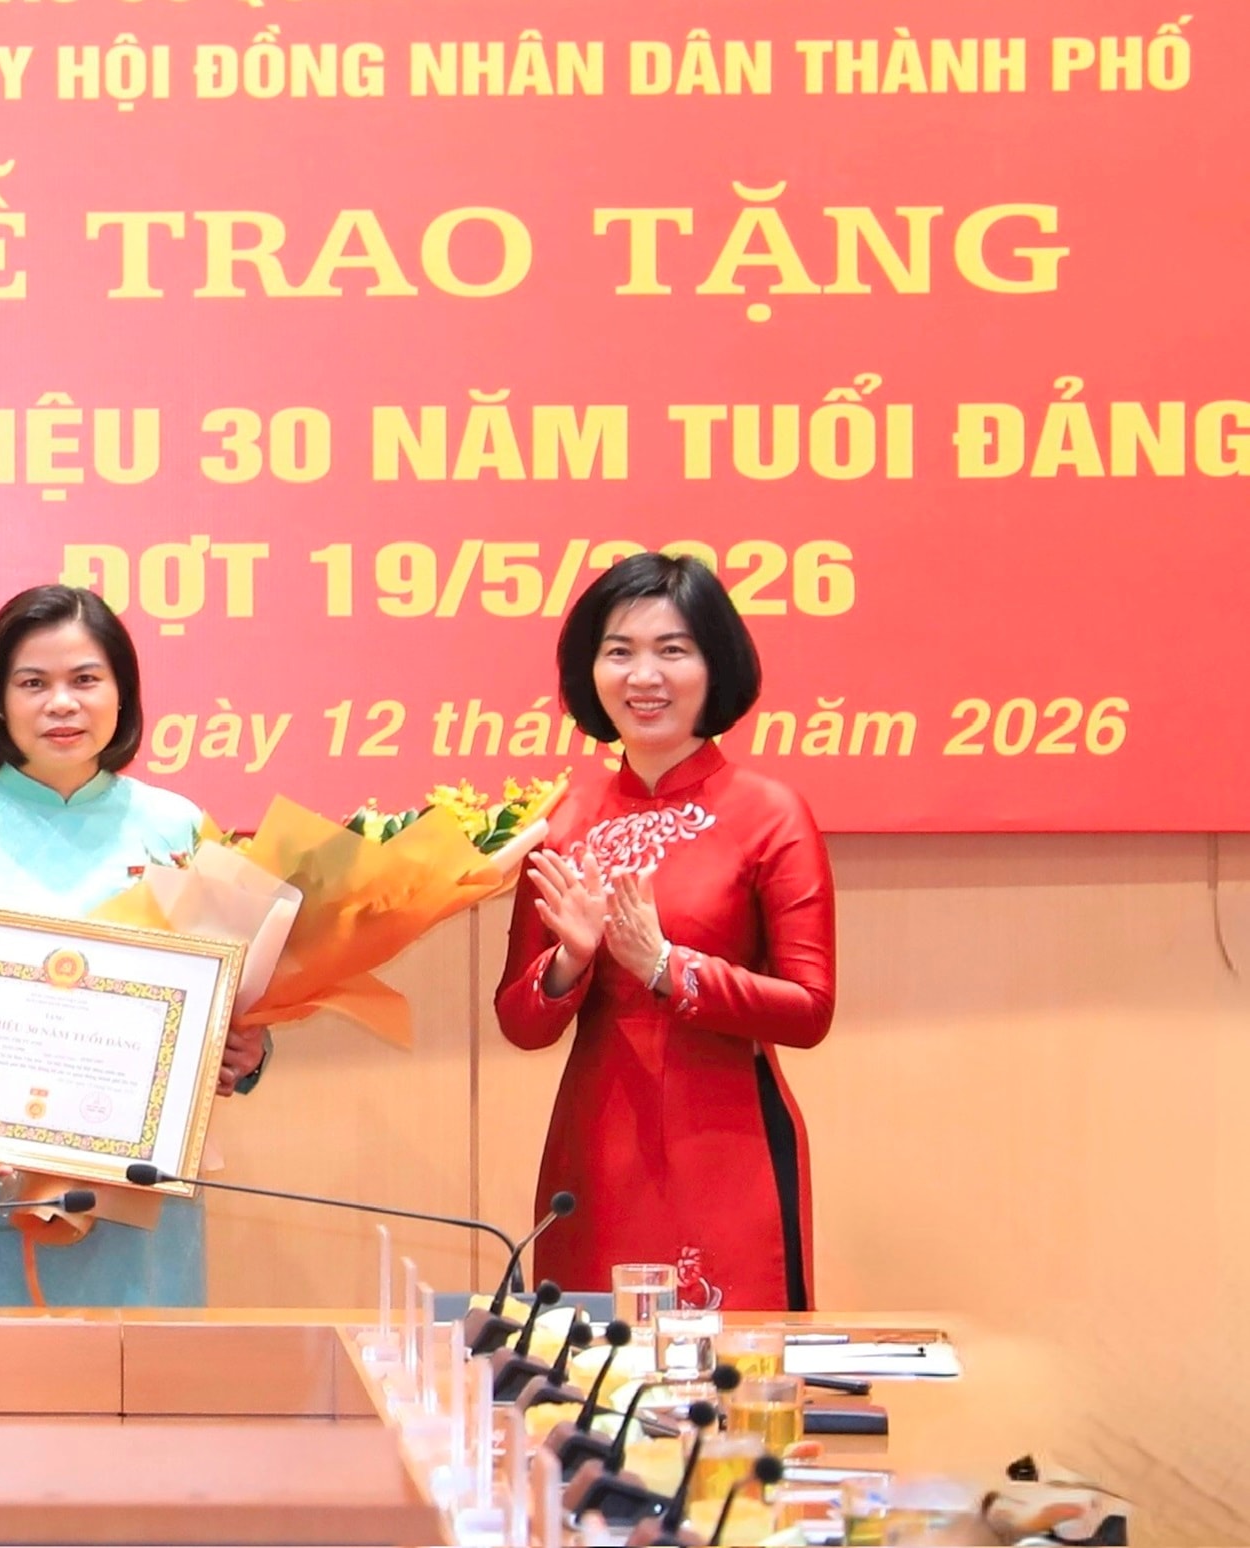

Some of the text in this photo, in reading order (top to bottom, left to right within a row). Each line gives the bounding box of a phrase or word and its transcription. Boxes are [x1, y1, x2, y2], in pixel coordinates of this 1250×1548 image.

[57, 33, 170, 112] HỘI
[193, 25, 385, 99] ĐỒNG
[410, 30, 604, 97] NHÂN
[629, 29, 772, 95] DÂN
[795, 27, 1026, 94] THÀNH
[1052, 15, 1194, 92] PHỐ
[85, 207, 533, 299] TRAO
[593, 180, 1071, 323] TẶNG
[200, 407, 332, 484] 30
[372, 389, 629, 481] NĂM
[668, 373, 914, 481] TUỔI
[953, 376, 1250, 478] ĐẢNG
[59, 534, 270, 636] ĐỢT
[147, 698, 292, 774] gày
[323, 700, 407, 757] 12
[751, 697, 917, 757] năm
[943, 697, 1131, 757] 2026
